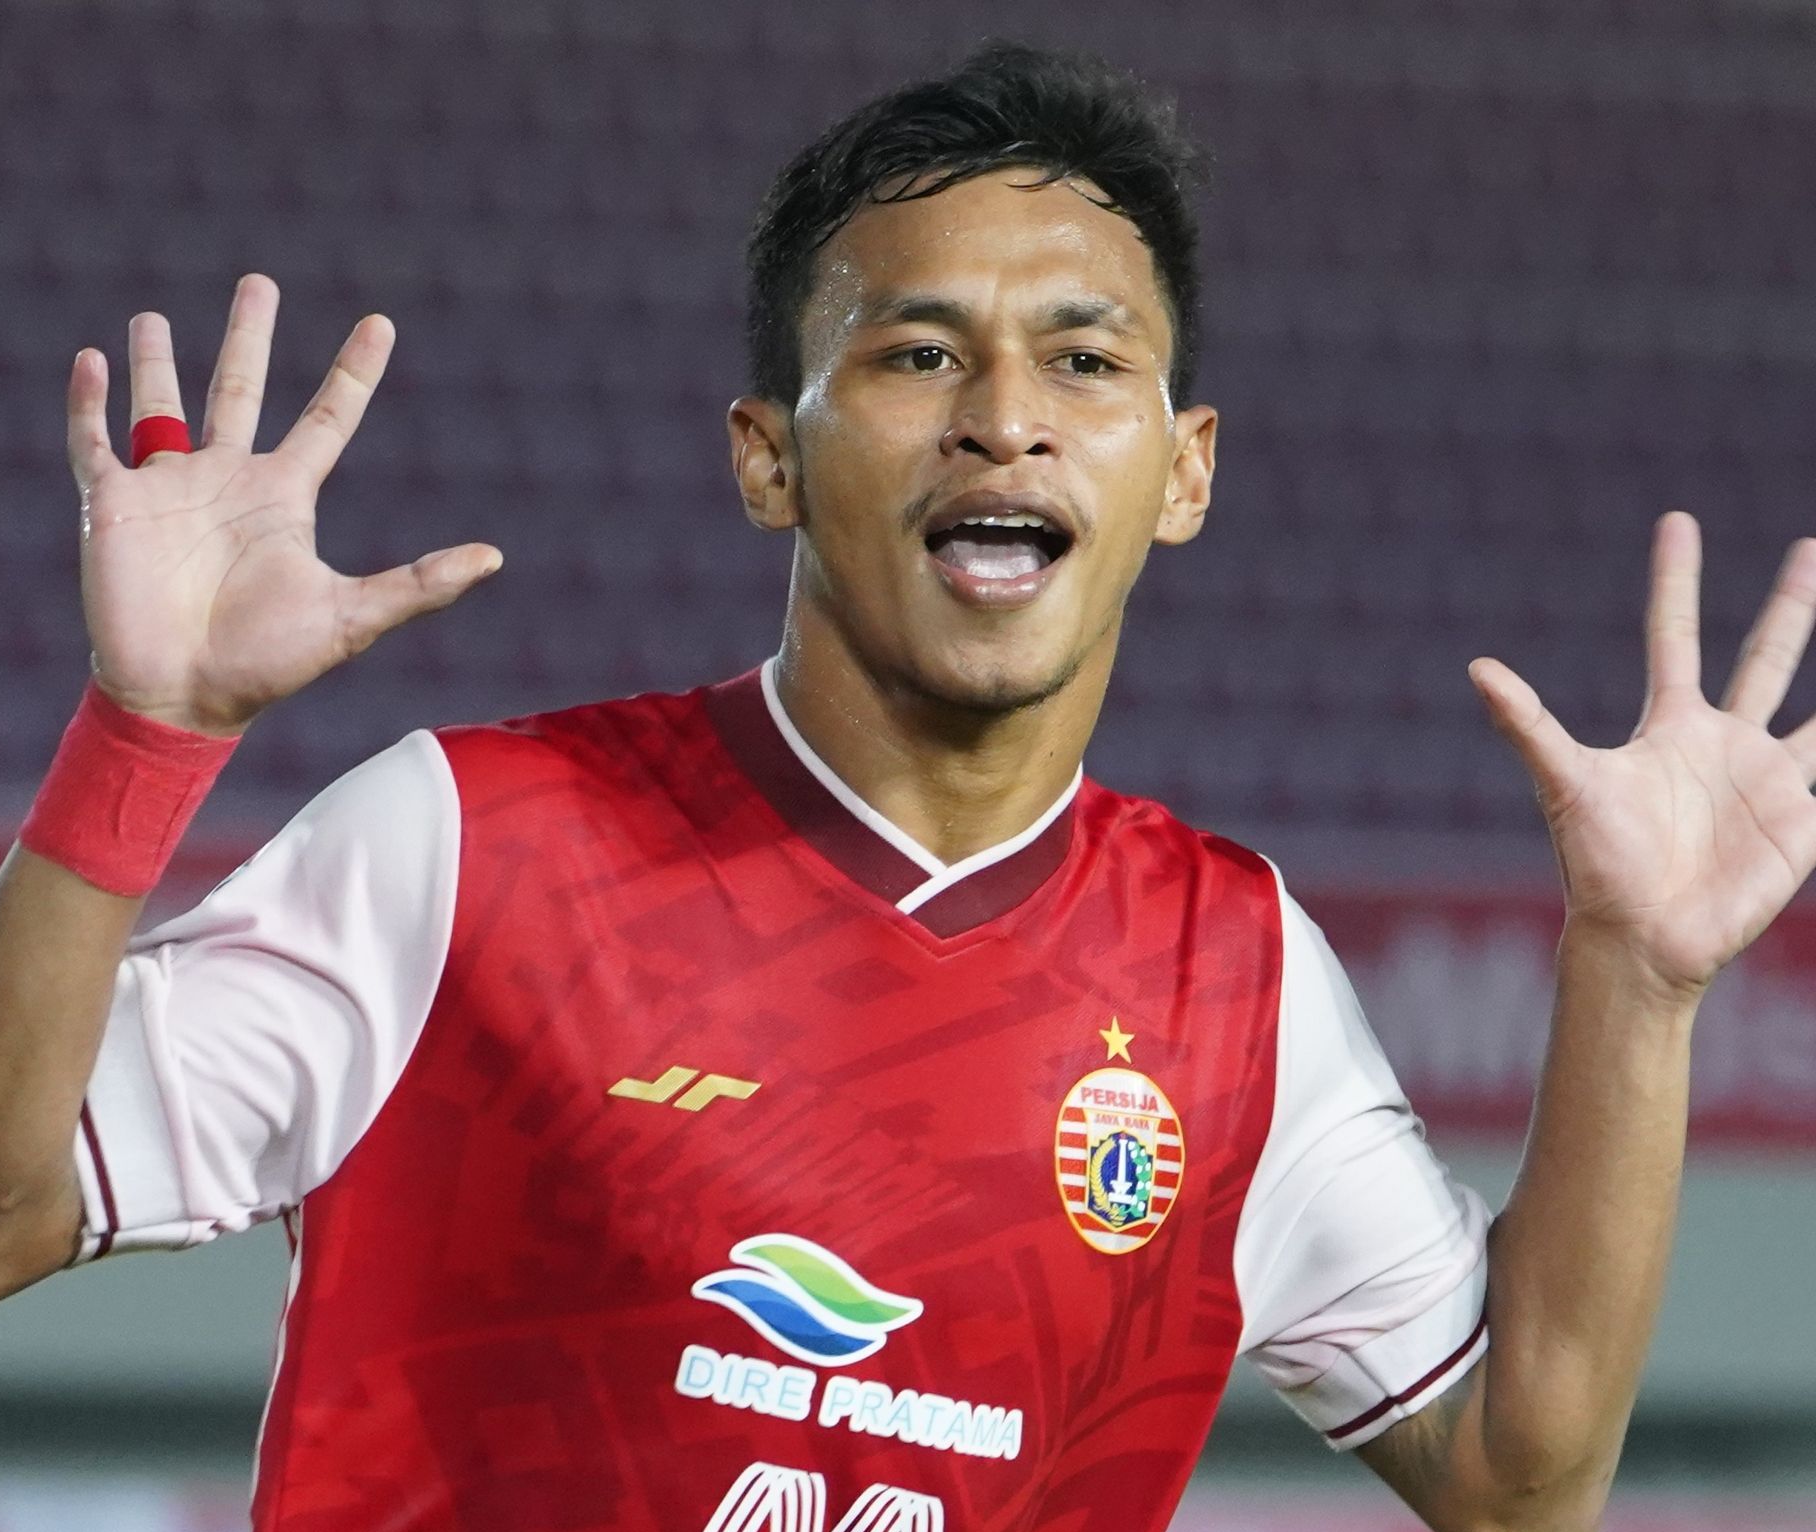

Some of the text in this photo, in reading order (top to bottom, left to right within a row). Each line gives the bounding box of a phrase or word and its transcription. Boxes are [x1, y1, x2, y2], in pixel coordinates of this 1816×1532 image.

[1080, 1086, 1159, 1112] PERSIJA
[680, 1349, 1020, 1455] DIRE PRATAMA
